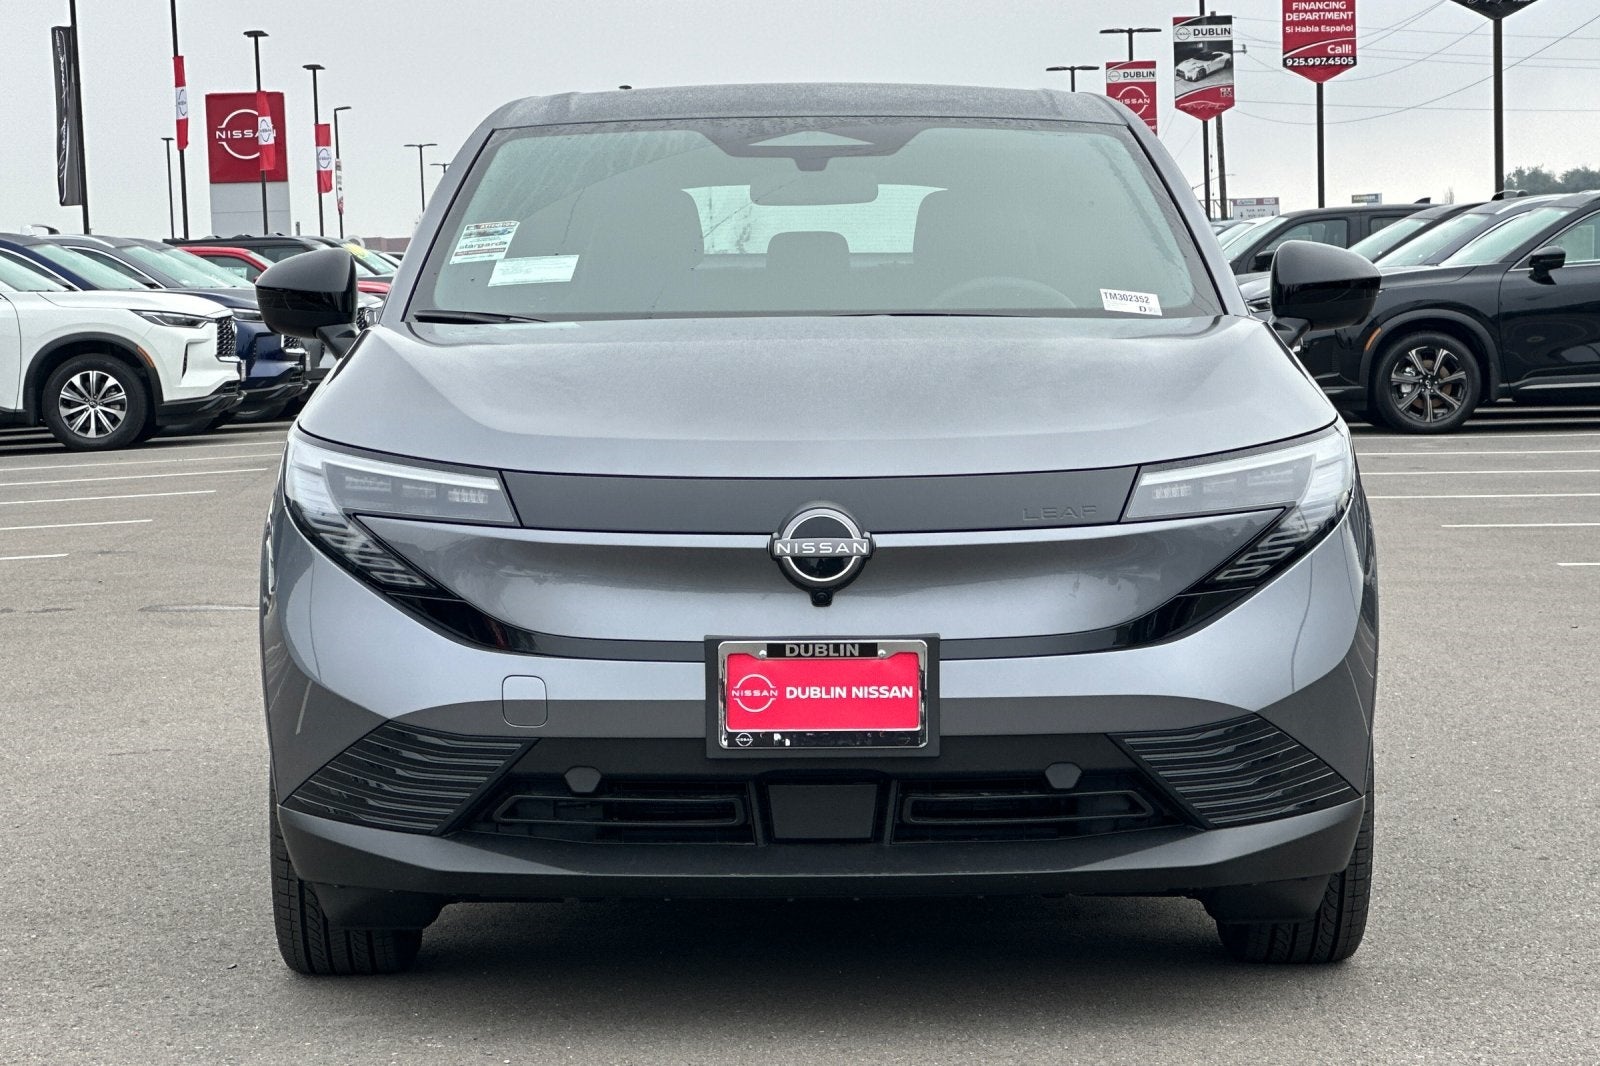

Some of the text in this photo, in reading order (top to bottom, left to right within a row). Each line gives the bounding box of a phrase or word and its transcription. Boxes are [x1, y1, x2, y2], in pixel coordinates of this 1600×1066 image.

[1292, 1, 1347, 10] FINANCING
[1285, 11, 1354, 20] DEPARTMENT
[1193, 27, 1231, 36] DUBLIN
[1285, 24, 1354, 33] Si Habla Español
[1327, 44, 1352, 54] Call!
[1286, 56, 1354, 66] 925.997.4505
[215, 129, 277, 140] NISS
[1104, 291, 1151, 304] TM302352
[1023, 504, 1097, 520] LEAF
[777, 542, 867, 554] NISSAN
[785, 643, 859, 657] DUBLIN
[732, 689, 778, 697] NISSAN
[785, 685, 913, 699] DUBLIN NISSAN
